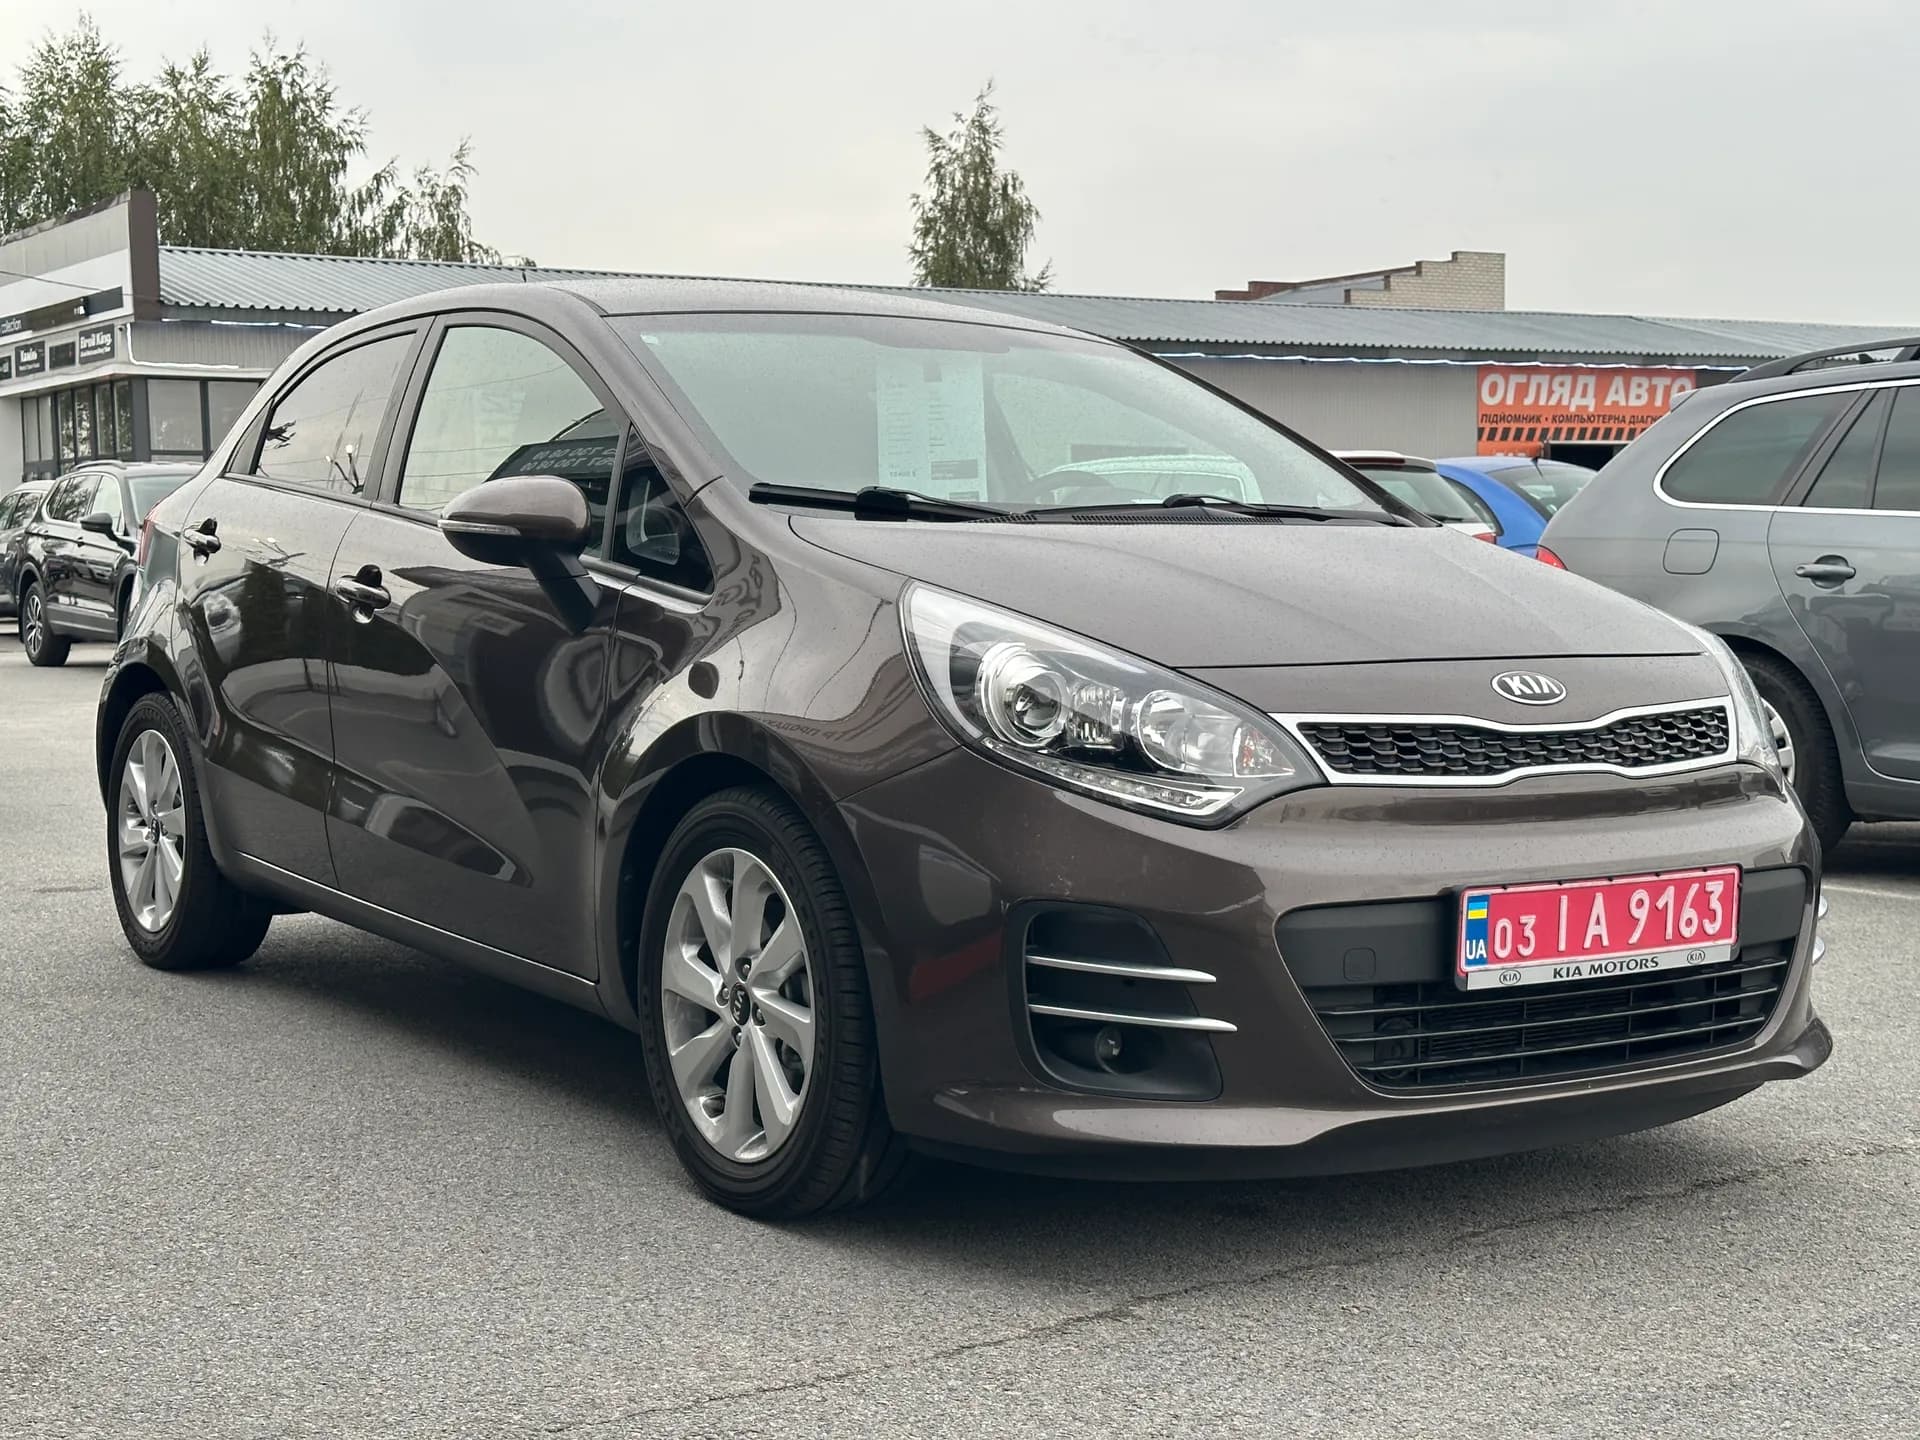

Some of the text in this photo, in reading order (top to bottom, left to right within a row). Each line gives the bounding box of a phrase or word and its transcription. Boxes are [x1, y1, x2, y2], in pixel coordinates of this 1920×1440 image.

[1481, 373, 1596, 412] ОГЛЯД
[1480, 411, 1542, 425] ПІДЙОМНИК
[1494, 914, 1536, 959] 03
[1628, 880, 1724, 945] 9163
[1466, 939, 1487, 960] UA
[1552, 955, 1660, 979] KIA MOTORS
